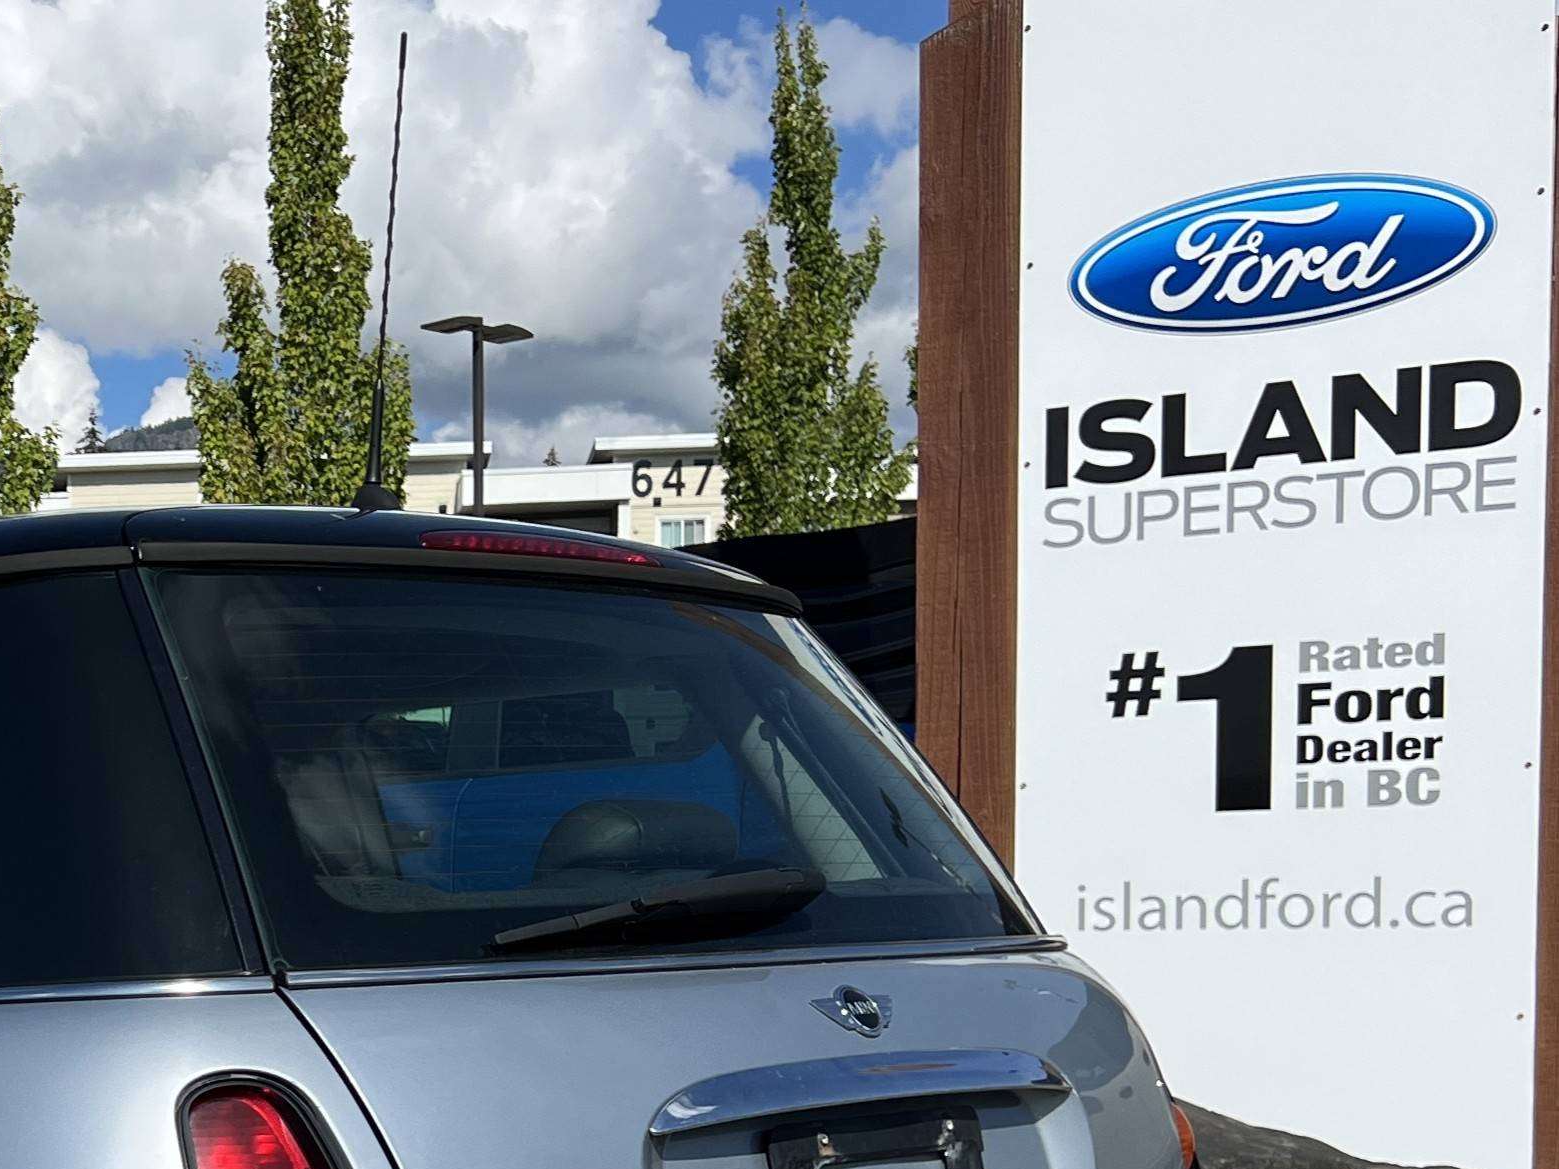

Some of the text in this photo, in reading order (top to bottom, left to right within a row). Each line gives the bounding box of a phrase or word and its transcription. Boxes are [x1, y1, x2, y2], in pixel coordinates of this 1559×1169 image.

[1150, 201, 1409, 312] Ford
[1045, 359, 1523, 489] ISLAND
[631, 459, 715, 498] 647
[1042, 455, 1517, 549] SUPERSTORE
[1298, 632, 1445, 673] Rated
[1296, 675, 1445, 725] Ford
[1105, 644, 1274, 812] #1
[1296, 731, 1444, 765] Dealer
[1295, 767, 1441, 809] in BC
[1077, 876, 1473, 933] islandford.ca
